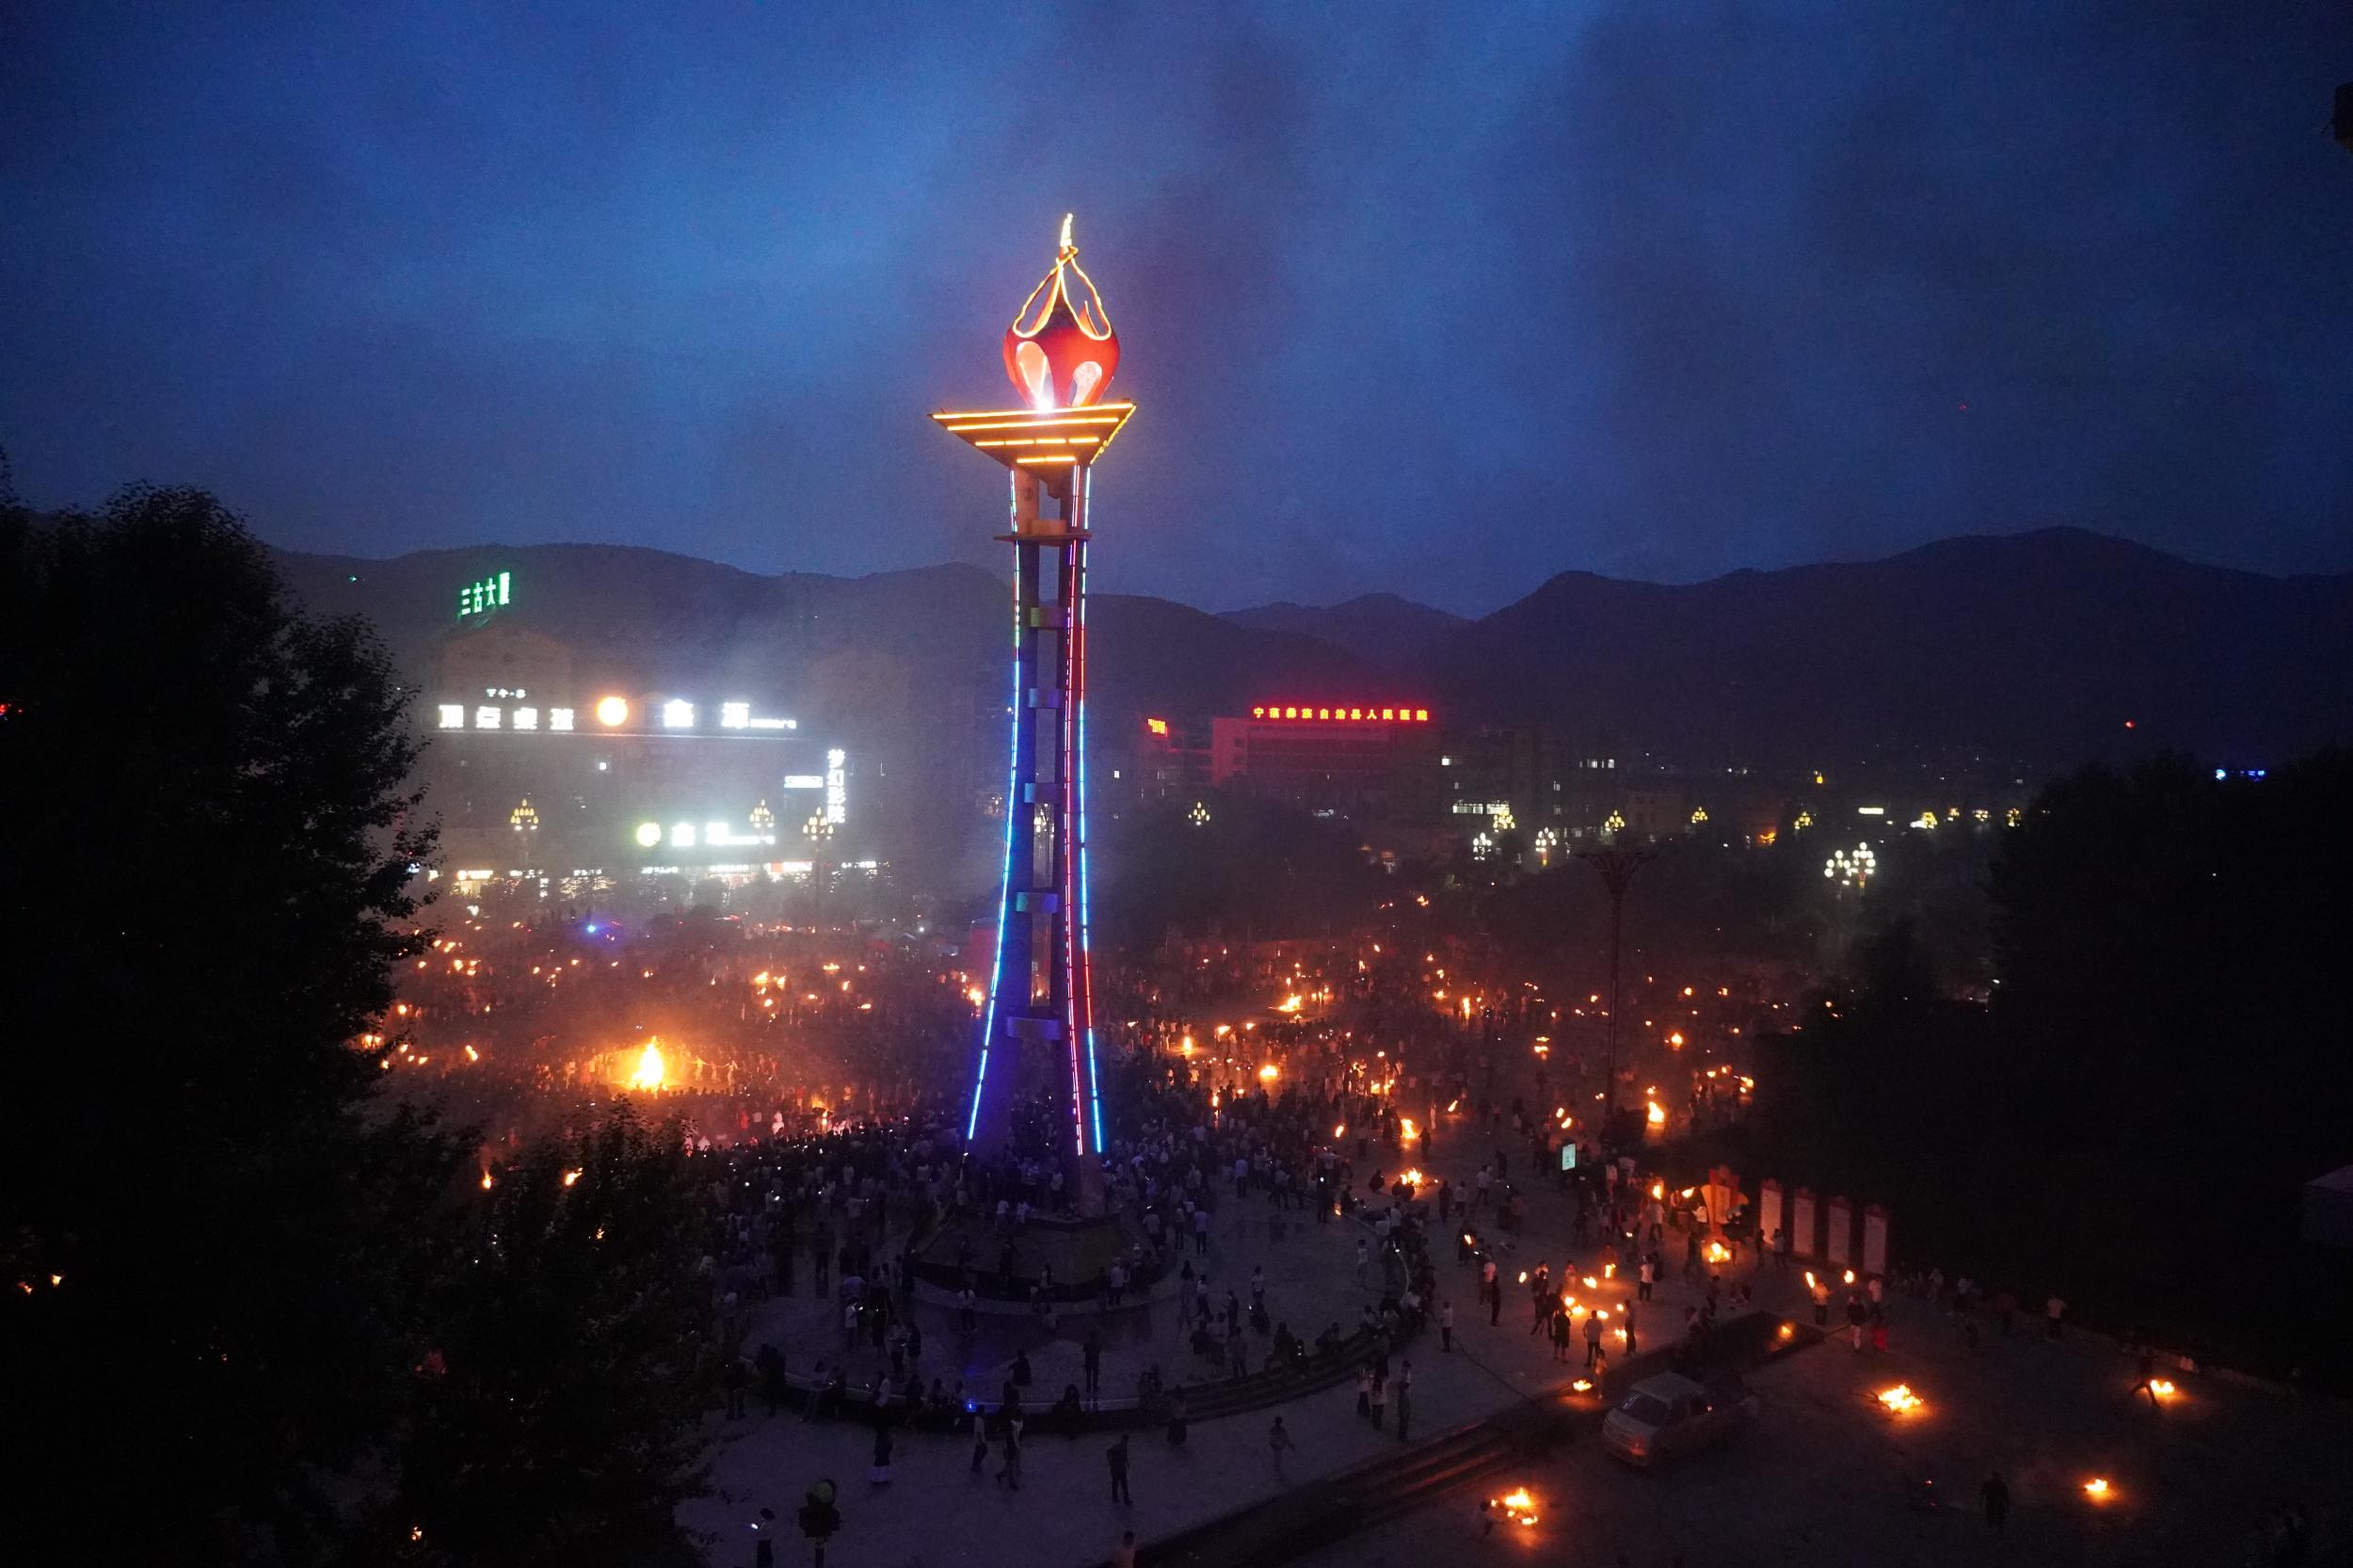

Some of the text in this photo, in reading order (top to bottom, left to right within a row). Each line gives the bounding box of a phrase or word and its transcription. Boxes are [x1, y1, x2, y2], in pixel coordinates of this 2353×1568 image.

[1253, 707, 1429, 721] 宁蒗彝族自治县人民医院
